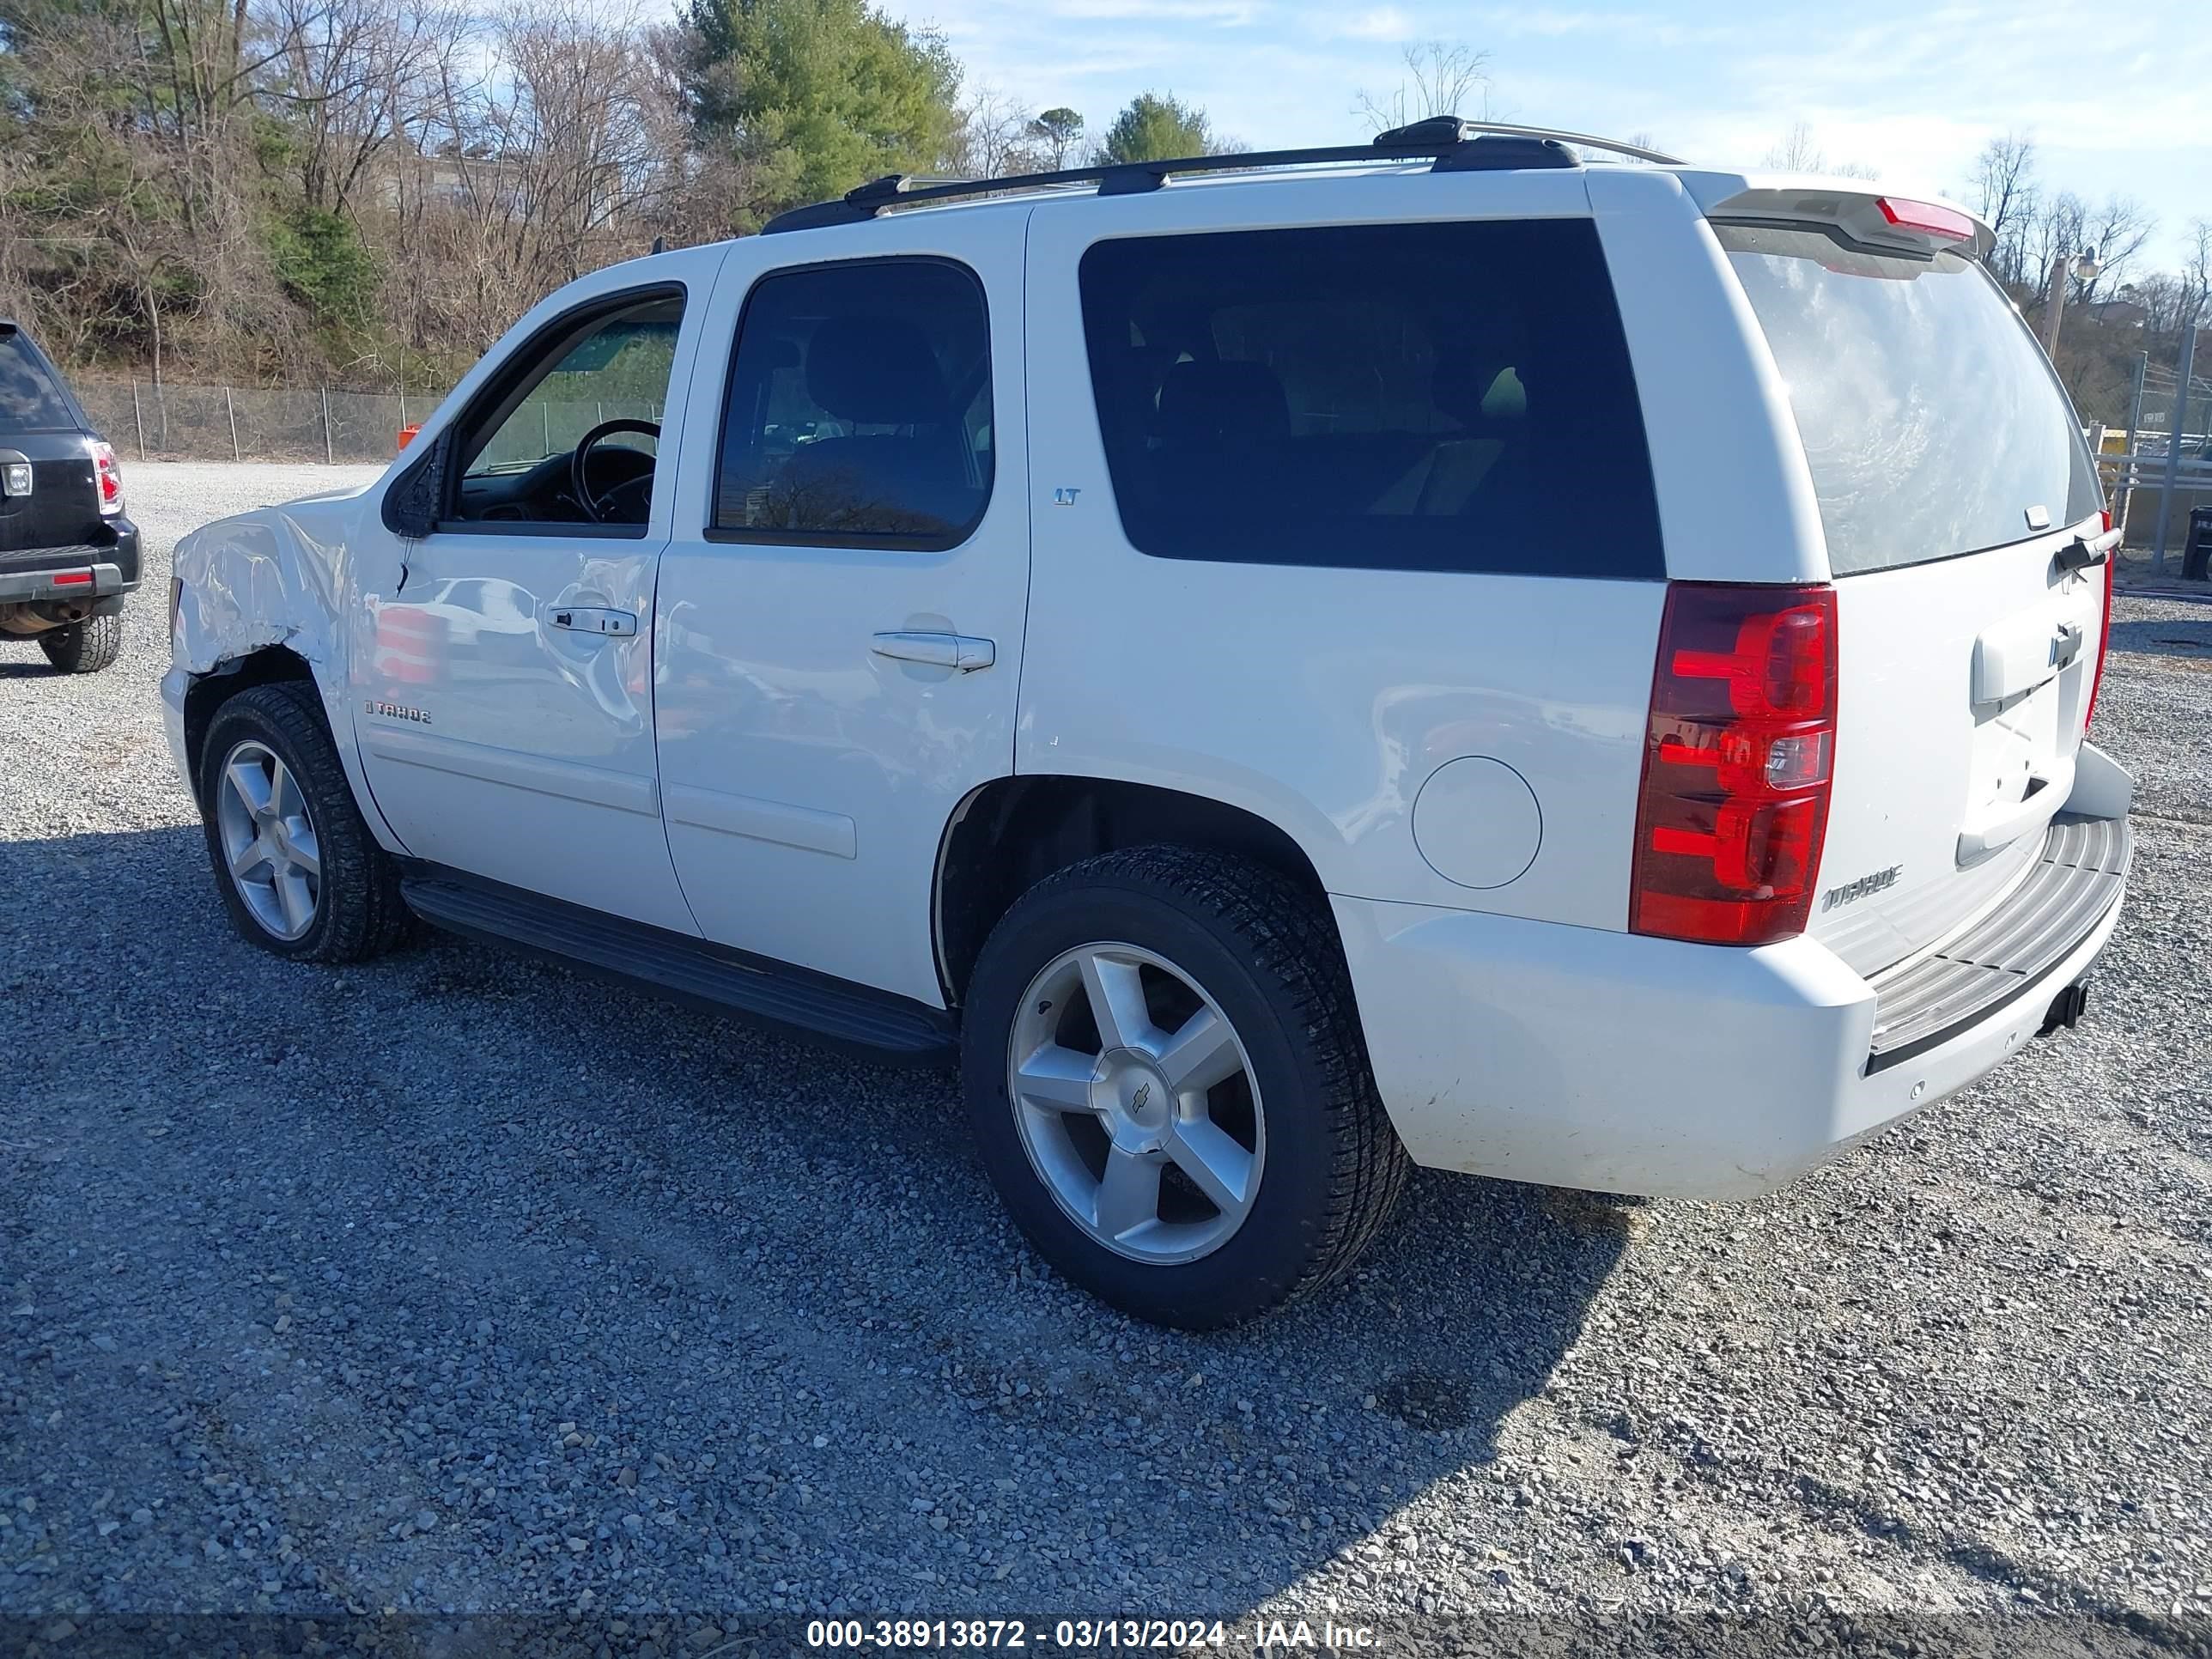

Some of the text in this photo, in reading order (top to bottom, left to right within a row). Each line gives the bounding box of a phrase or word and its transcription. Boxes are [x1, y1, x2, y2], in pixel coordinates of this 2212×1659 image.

[1054, 488, 1081, 505] LT
[375, 701, 432, 725] TAHOE
[1821, 864, 1904, 914] TAHOE
